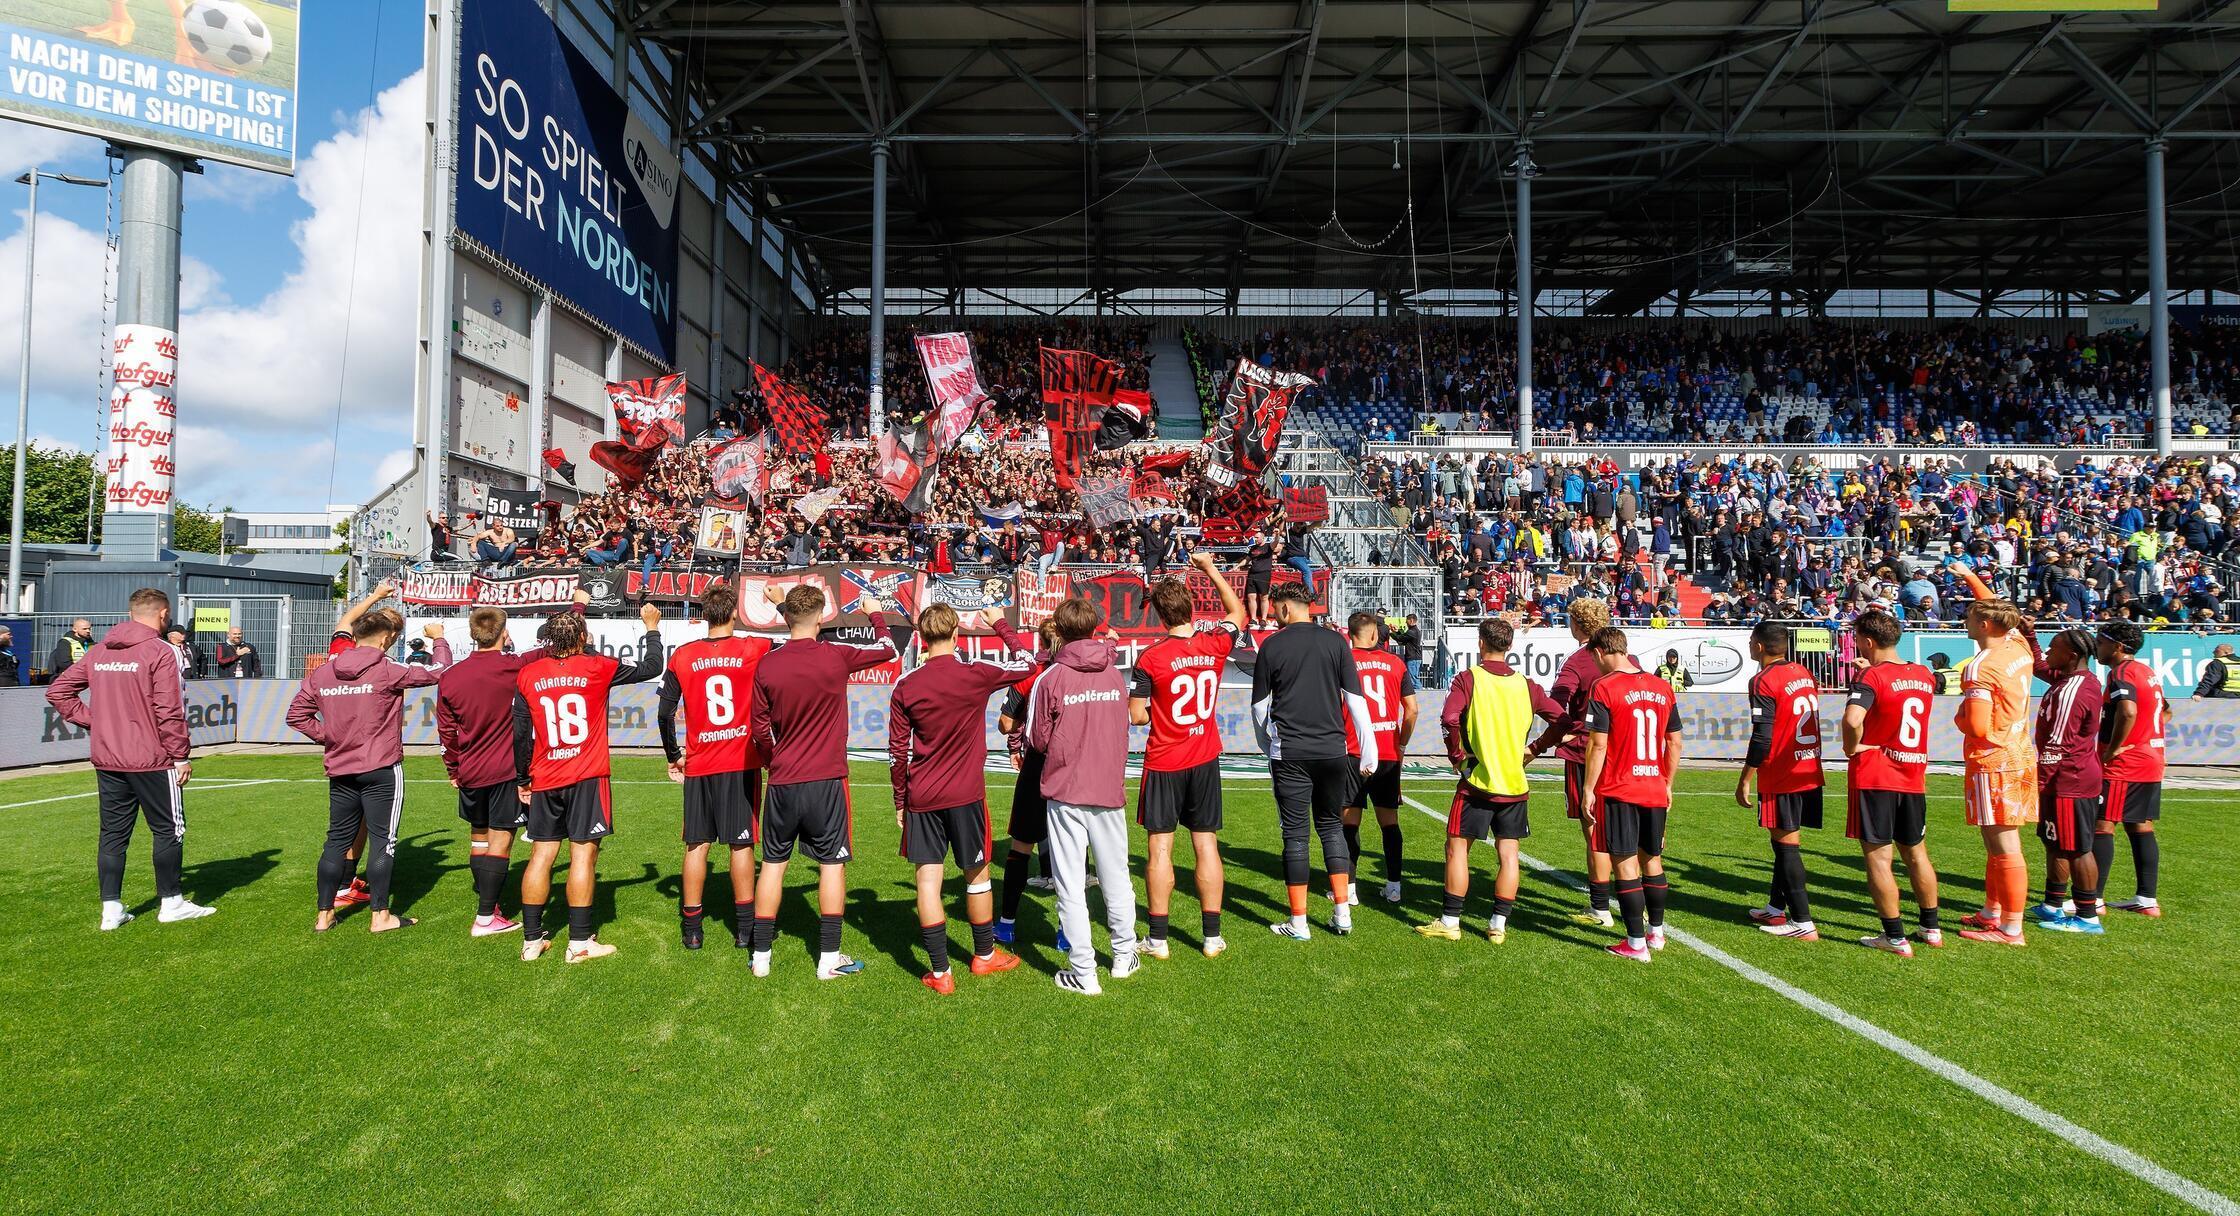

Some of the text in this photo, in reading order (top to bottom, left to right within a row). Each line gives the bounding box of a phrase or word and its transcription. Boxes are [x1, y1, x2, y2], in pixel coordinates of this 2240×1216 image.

[10, 33, 286, 119] NACH DEM SPIEL IST
[9, 65, 284, 148] VOR DEM SHOPPING!
[475, 53, 627, 228] SO SPIELT
[626, 138, 673, 198] CASINO
[474, 124, 669, 323] DER NORDEN
[114, 361, 175, 388] Hofgut
[112, 421, 174, 447] Hofgut
[108, 480, 172, 507] Hofgut
[488, 498, 510, 515] 50
[486, 517, 538, 528] USETZEN
[405, 571, 471, 599] H3RZBLUT
[1019, 570, 1067, 592] SEKION
[197, 615, 221, 623] INNEN
[692, 657, 743, 673] NÜRNBERG
[1170, 655, 1215, 672] NÜRNBERG
[534, 676, 588, 693] NÜRNBERG
[1170, 669, 1218, 725] 20
[1363, 674, 1386, 718] 4
[1891, 678, 1933, 693] NÜRNBERG
[705, 674, 735, 726] 8
[539, 693, 588, 748] 18
[698, 725, 748, 743] FERNANDEZ
[1899, 697, 1925, 748] 6
[1632, 708, 1658, 761] 11
